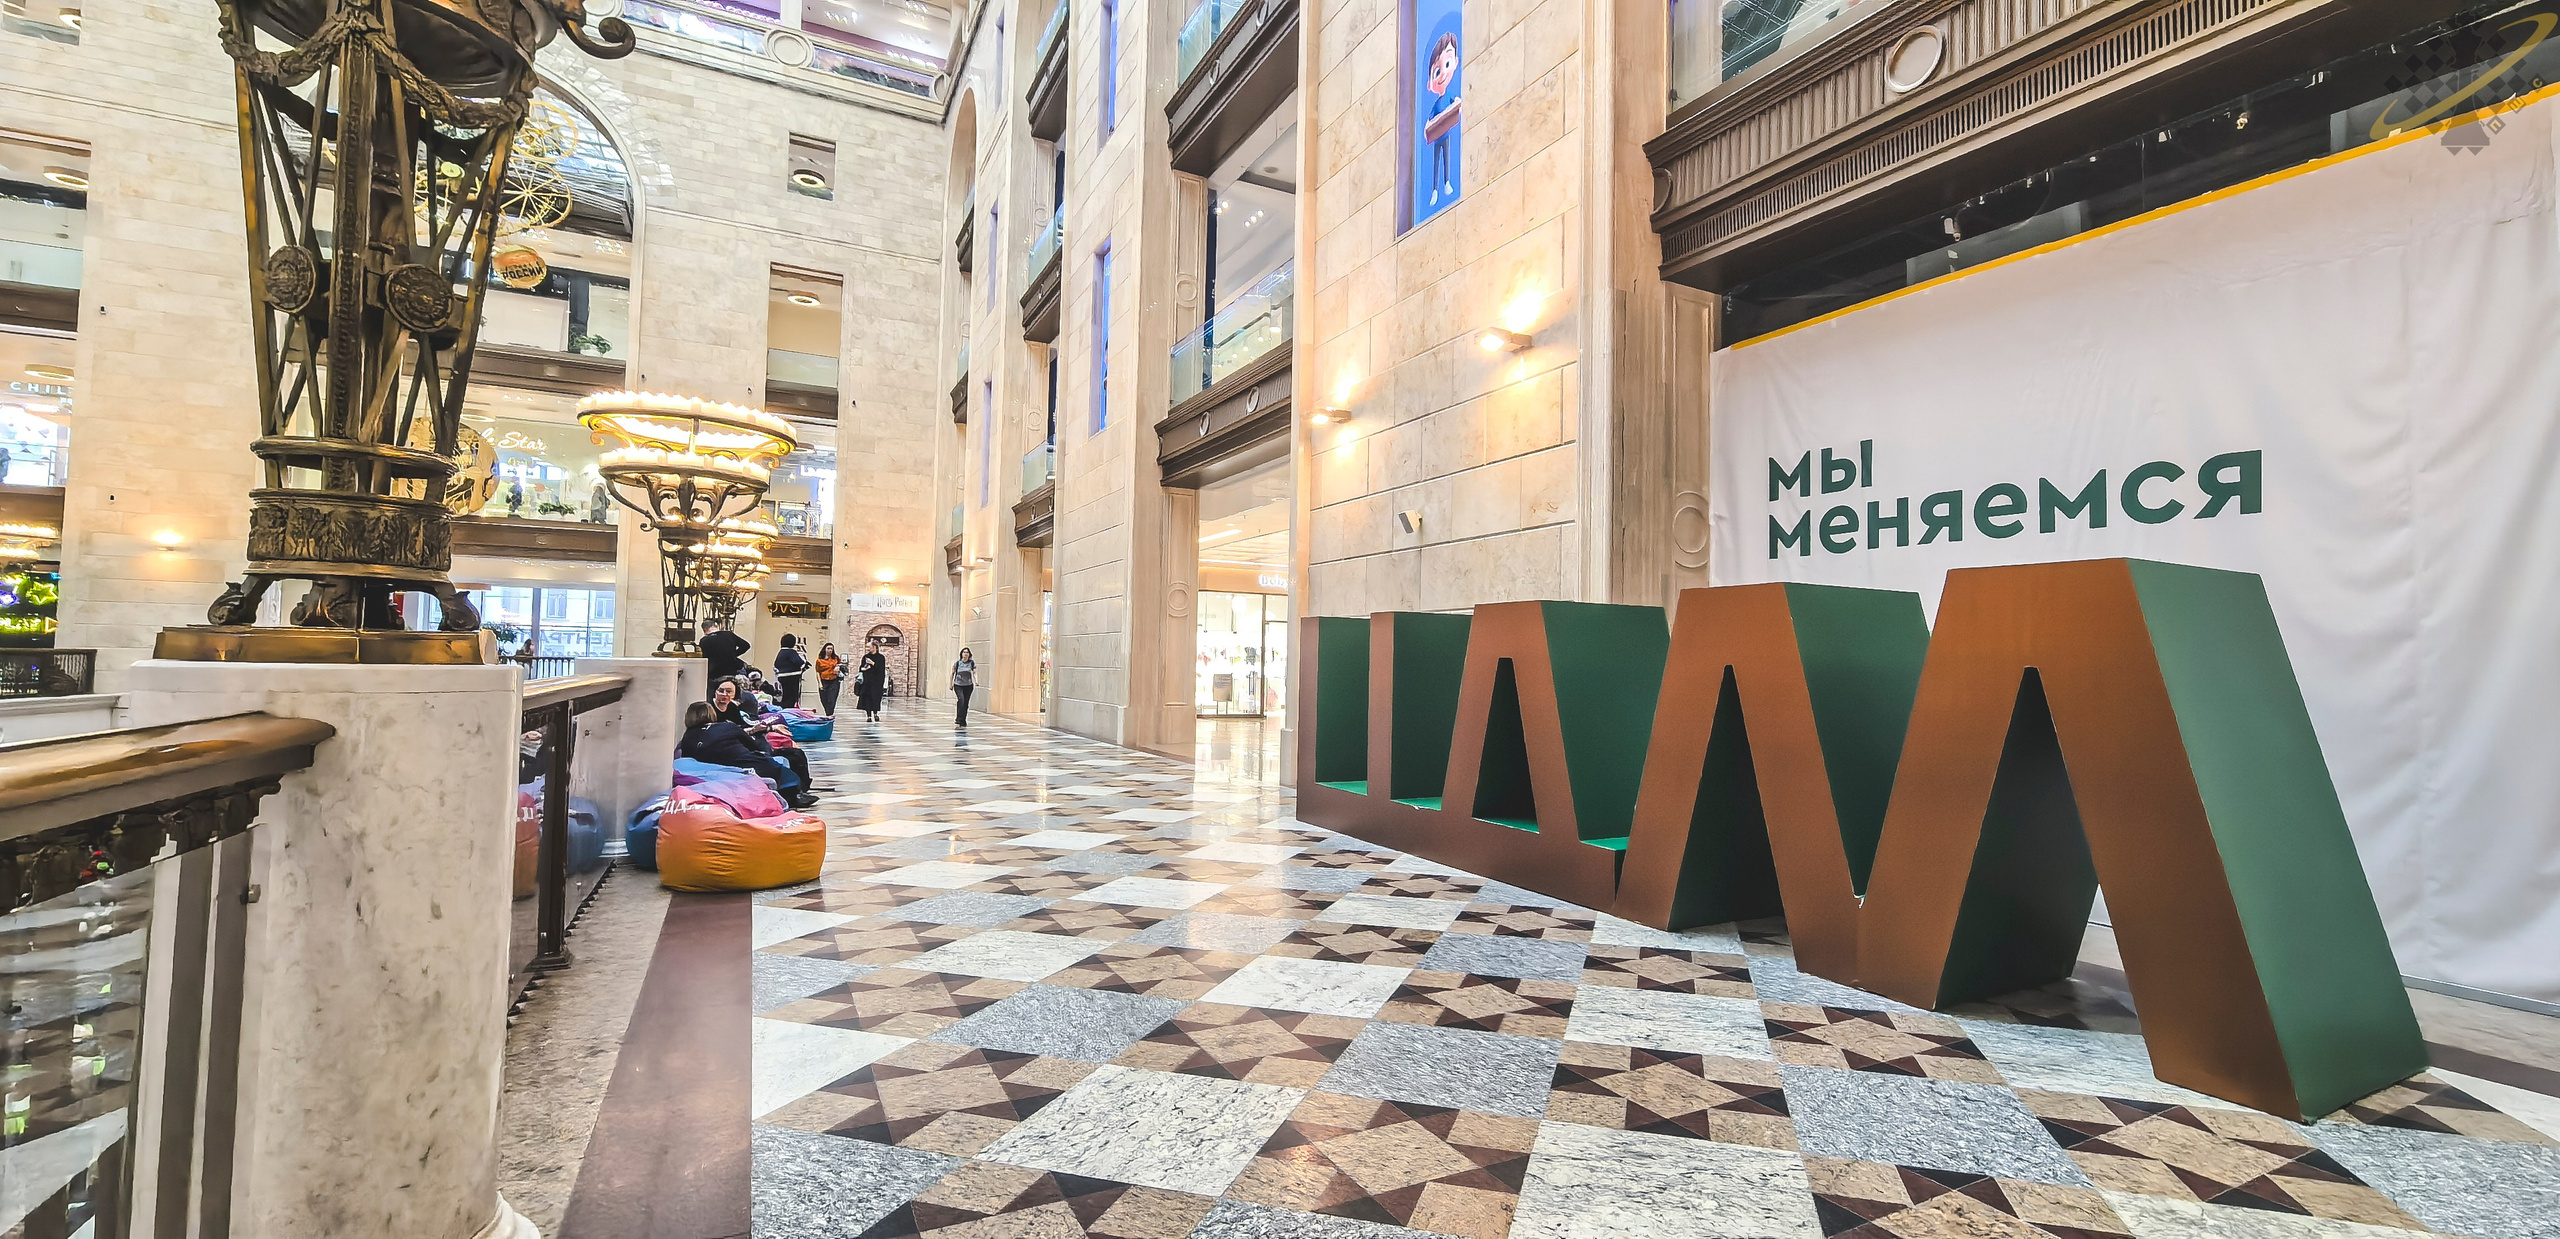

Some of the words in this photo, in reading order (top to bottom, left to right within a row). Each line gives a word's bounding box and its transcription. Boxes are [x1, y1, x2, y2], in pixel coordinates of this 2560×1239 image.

[9, 381, 73, 395] CHIL
[498, 431, 547, 450] Star
[1767, 448, 2264, 561] меняемся
